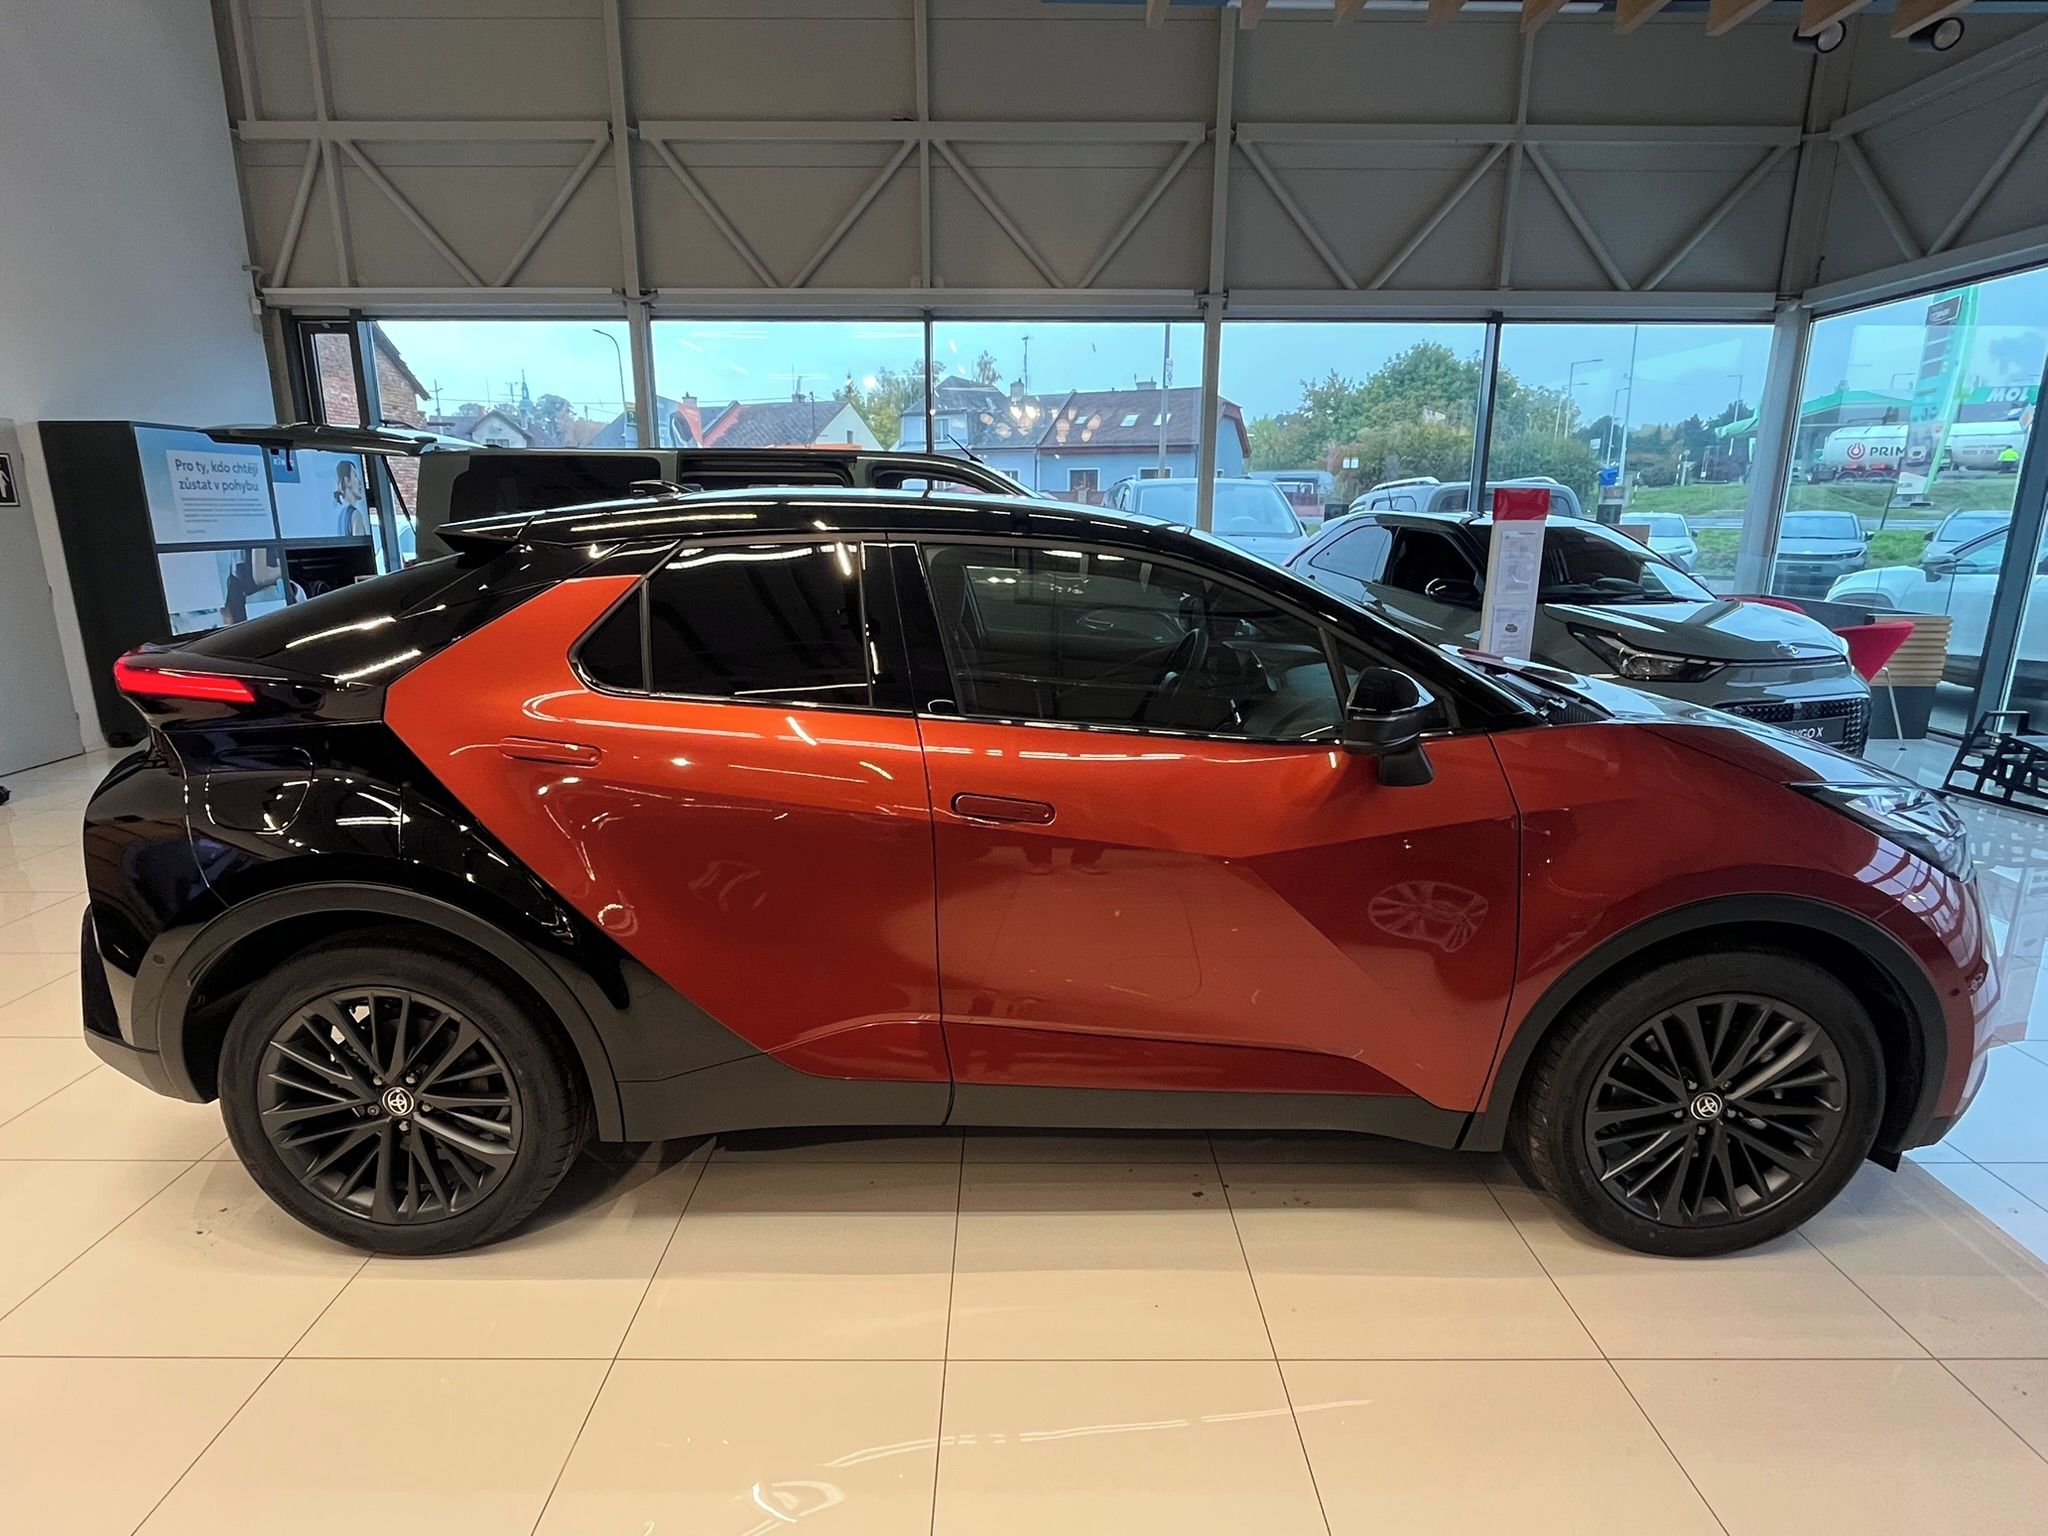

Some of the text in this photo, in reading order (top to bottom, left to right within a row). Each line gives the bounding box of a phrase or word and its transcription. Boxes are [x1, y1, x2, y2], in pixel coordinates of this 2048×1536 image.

[1986, 387, 2029, 402] MOL
[175, 459, 194, 472] Pro
[195, 461, 210, 475] ty,
[211, 461, 231, 473] kdo
[179, 477, 259, 494] zůstat v pohybu
